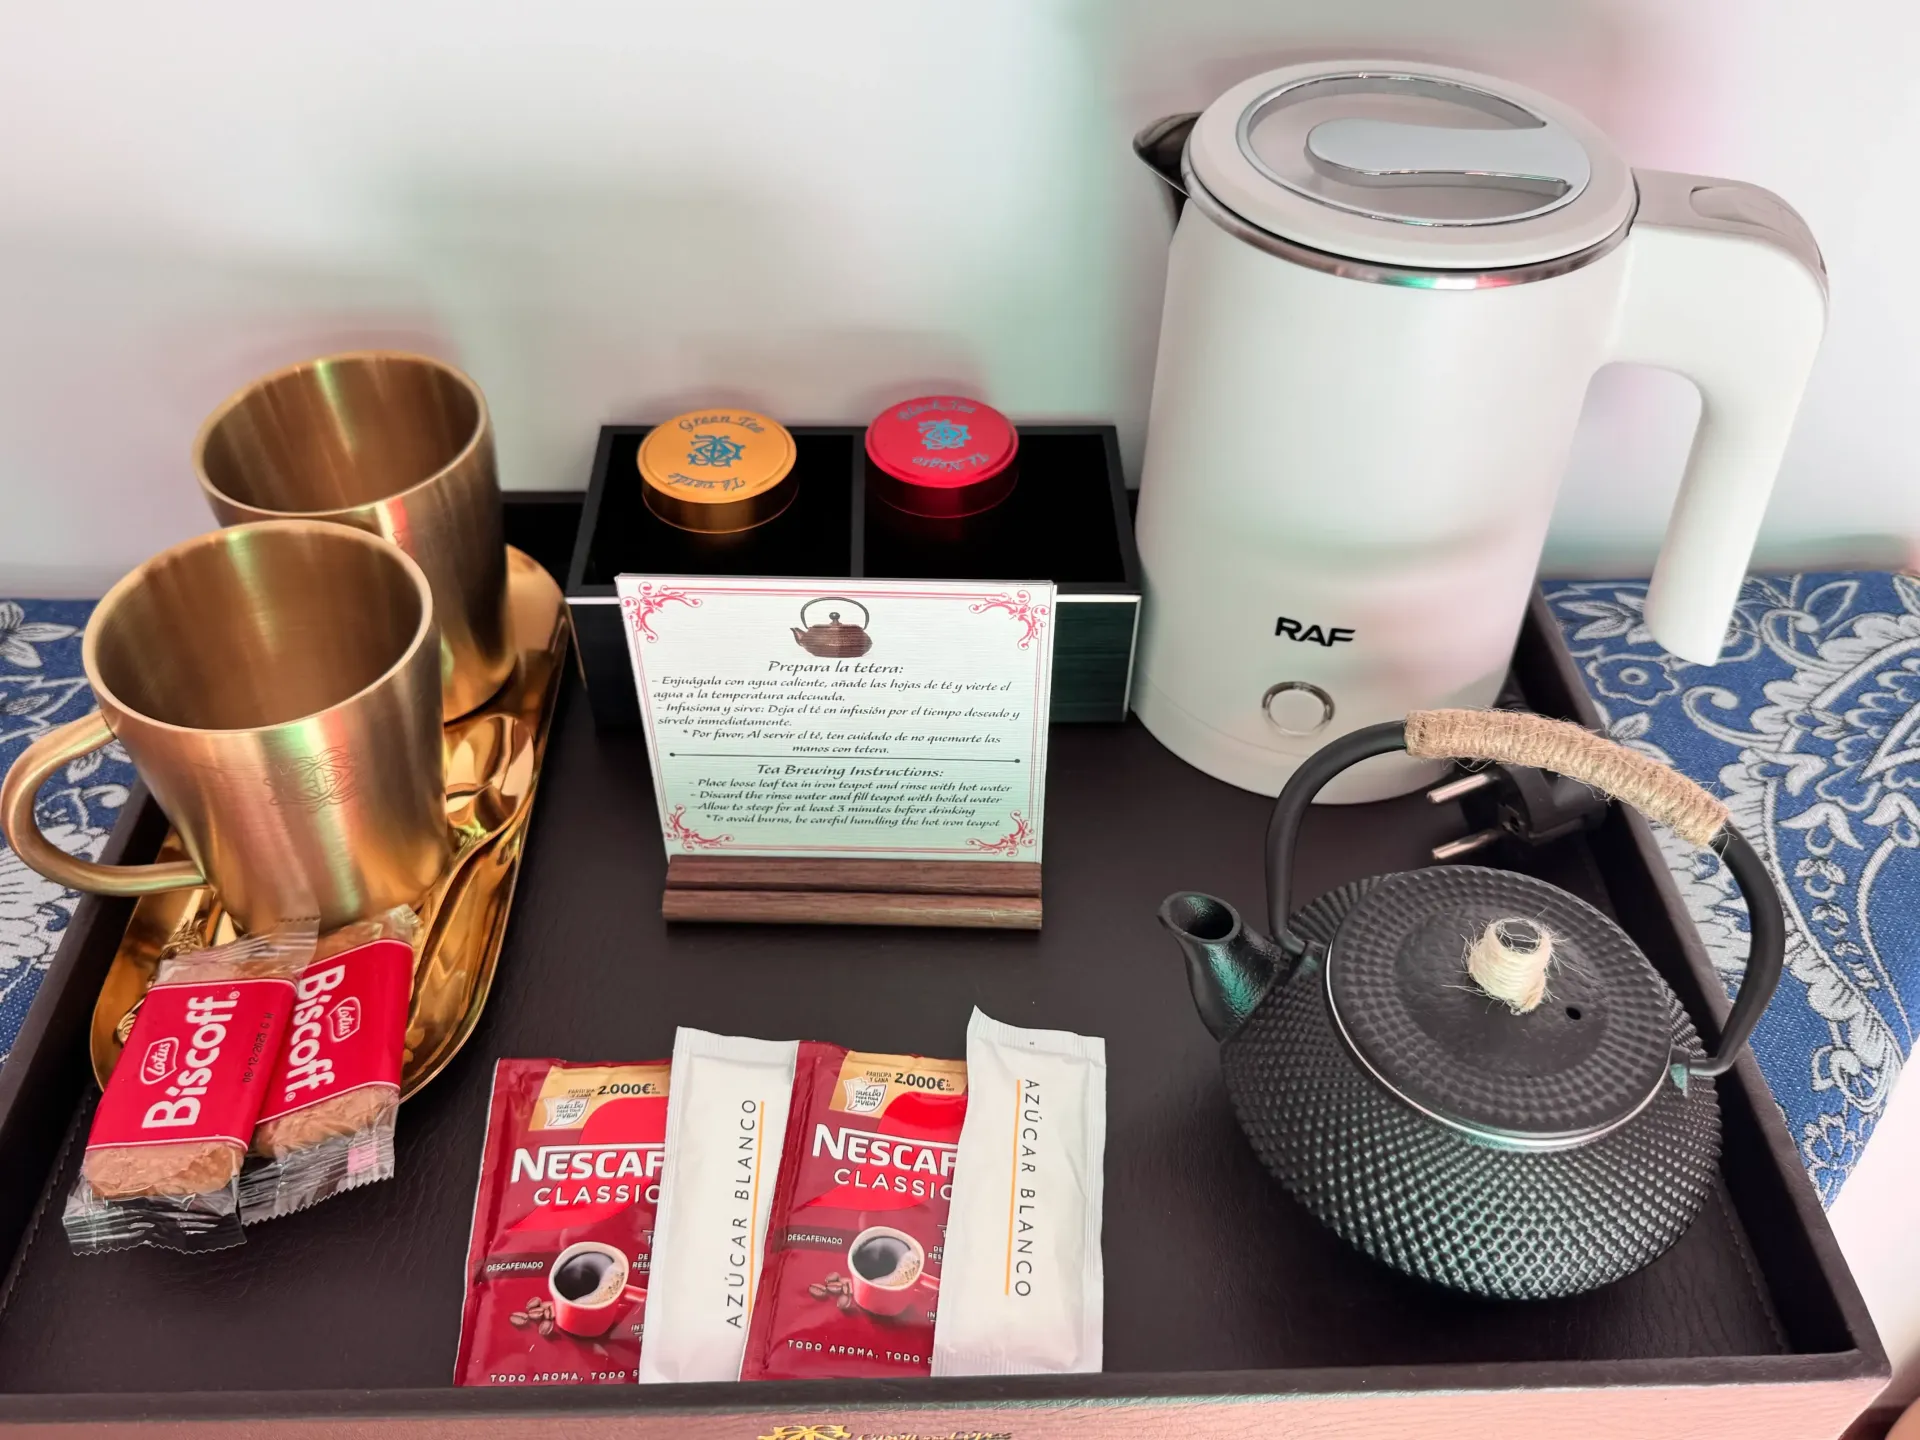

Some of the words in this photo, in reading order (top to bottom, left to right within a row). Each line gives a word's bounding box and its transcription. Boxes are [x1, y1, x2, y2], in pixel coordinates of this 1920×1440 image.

[679, 416, 731, 432] Green
[739, 416, 765, 433] Tea
[1275, 616, 1356, 647] RAF
[768, 661, 830, 676] Prepara
[835, 661, 849, 672] la
[854, 663, 903, 673] tetera:
[662, 676, 721, 688] Enjuágala
[748, 679, 777, 689] agua
[780, 678, 827, 688] caliente,
[832, 678, 866, 688] añade
[870, 679, 887, 688] las
[890, 679, 921, 692] hojas
[924, 680, 937, 689] de
[941, 682, 952, 690] té
[952, 684, 963, 693] y
[966, 682, 997, 691] vierte
[1000, 682, 1011, 691] el
[654, 691, 683, 699] agua
[698, 690, 708, 699] la
[712, 691, 783, 702] temperatura
[786, 692, 845, 701] adecuada.
[666, 703, 720, 714] Infusiona
[723, 706, 731, 715] y
[734, 705, 764, 713] sirve:
[768, 705, 794, 716] Deja
[798, 705, 807, 713] el
[839, 704, 886, 717] infusión
[887, 708, 908, 718] por
[911, 706, 921, 716] el
[923, 708, 961, 719] tiempo
[964, 708, 1009, 718] deseado
[1009, 711, 1020, 721] y
[658, 717, 694, 725] sírvelo
[698, 716, 792, 727] inmediatamente.
[692, 730, 711, 738] Por
[714, 730, 744, 740] favor,
[747, 731, 760, 739] Al
[763, 731, 795, 739] servir
[798, 731, 807, 740] el
[810, 732, 823, 741] té,
[847, 732, 892, 741] cuidado
[895, 733, 907, 741] de
[927, 735, 982, 744] quemarte
[984, 733, 1001, 743] las
[832, 744, 851, 752] con
[854, 746, 889, 754] tetera.
[758, 764, 780, 775] Tea
[784, 764, 845, 779] Brewing
[850, 766, 944, 777] Instructions:
[698, 779, 727, 787] Place
[730, 779, 756, 787] loose
[759, 779, 780, 790] leaf
[838, 781, 874, 791] teapot
[876, 781, 899, 790] and
[930, 783, 956, 791] with
[958, 783, 977, 791] hot
[700, 791, 742, 799] Discard
[745, 791, 763, 799] the
[766, 792, 792, 800] rinse
[828, 792, 851, 800] and
[852, 793, 869, 803] fill
[871, 795, 905, 804] teapot
[907, 794, 932, 803] with
[936, 795, 967, 803] boiled
[746, 805, 773, 813] steep
[775, 804, 792, 814] for
[848, 805, 891, 814] minutes
[894, 805, 926, 816] before
[929, 806, 975, 817] drinking
[726, 815, 755, 823] avoid
[758, 815, 792, 824] burns,
[795, 815, 807, 824] be
[810, 816, 848, 826] careful
[850, 817, 898, 828] handling
[902, 817, 919, 826] the
[922, 817, 940, 827] hot
[967, 819, 1000, 829] teapot
[337, 1005, 355, 1036] Lotus
[146, 1042, 172, 1077] Lotus
[1021, 1078, 1043, 1173] AZÚCAR
[734, 1100, 757, 1202] BLANCO
[812, 1123, 960, 1178] NESCAF
[511, 1143, 665, 1183] NESCAF
[787, 1233, 843, 1245] DESCAFEINADO
[1015, 1188, 1037, 1298] BLANCO
[487, 1260, 545, 1272] DESCAFEINADO
[725, 1217, 748, 1329] AZÚCAR
[788, 1339, 823, 1351] TODO
[829, 1345, 880, 1359] AROMA,
[886, 1351, 921, 1363] TODO
[491, 1373, 527, 1383] TODO
[533, 1372, 585, 1383] AROMA,
[591, 1369, 626, 1380] TODO
